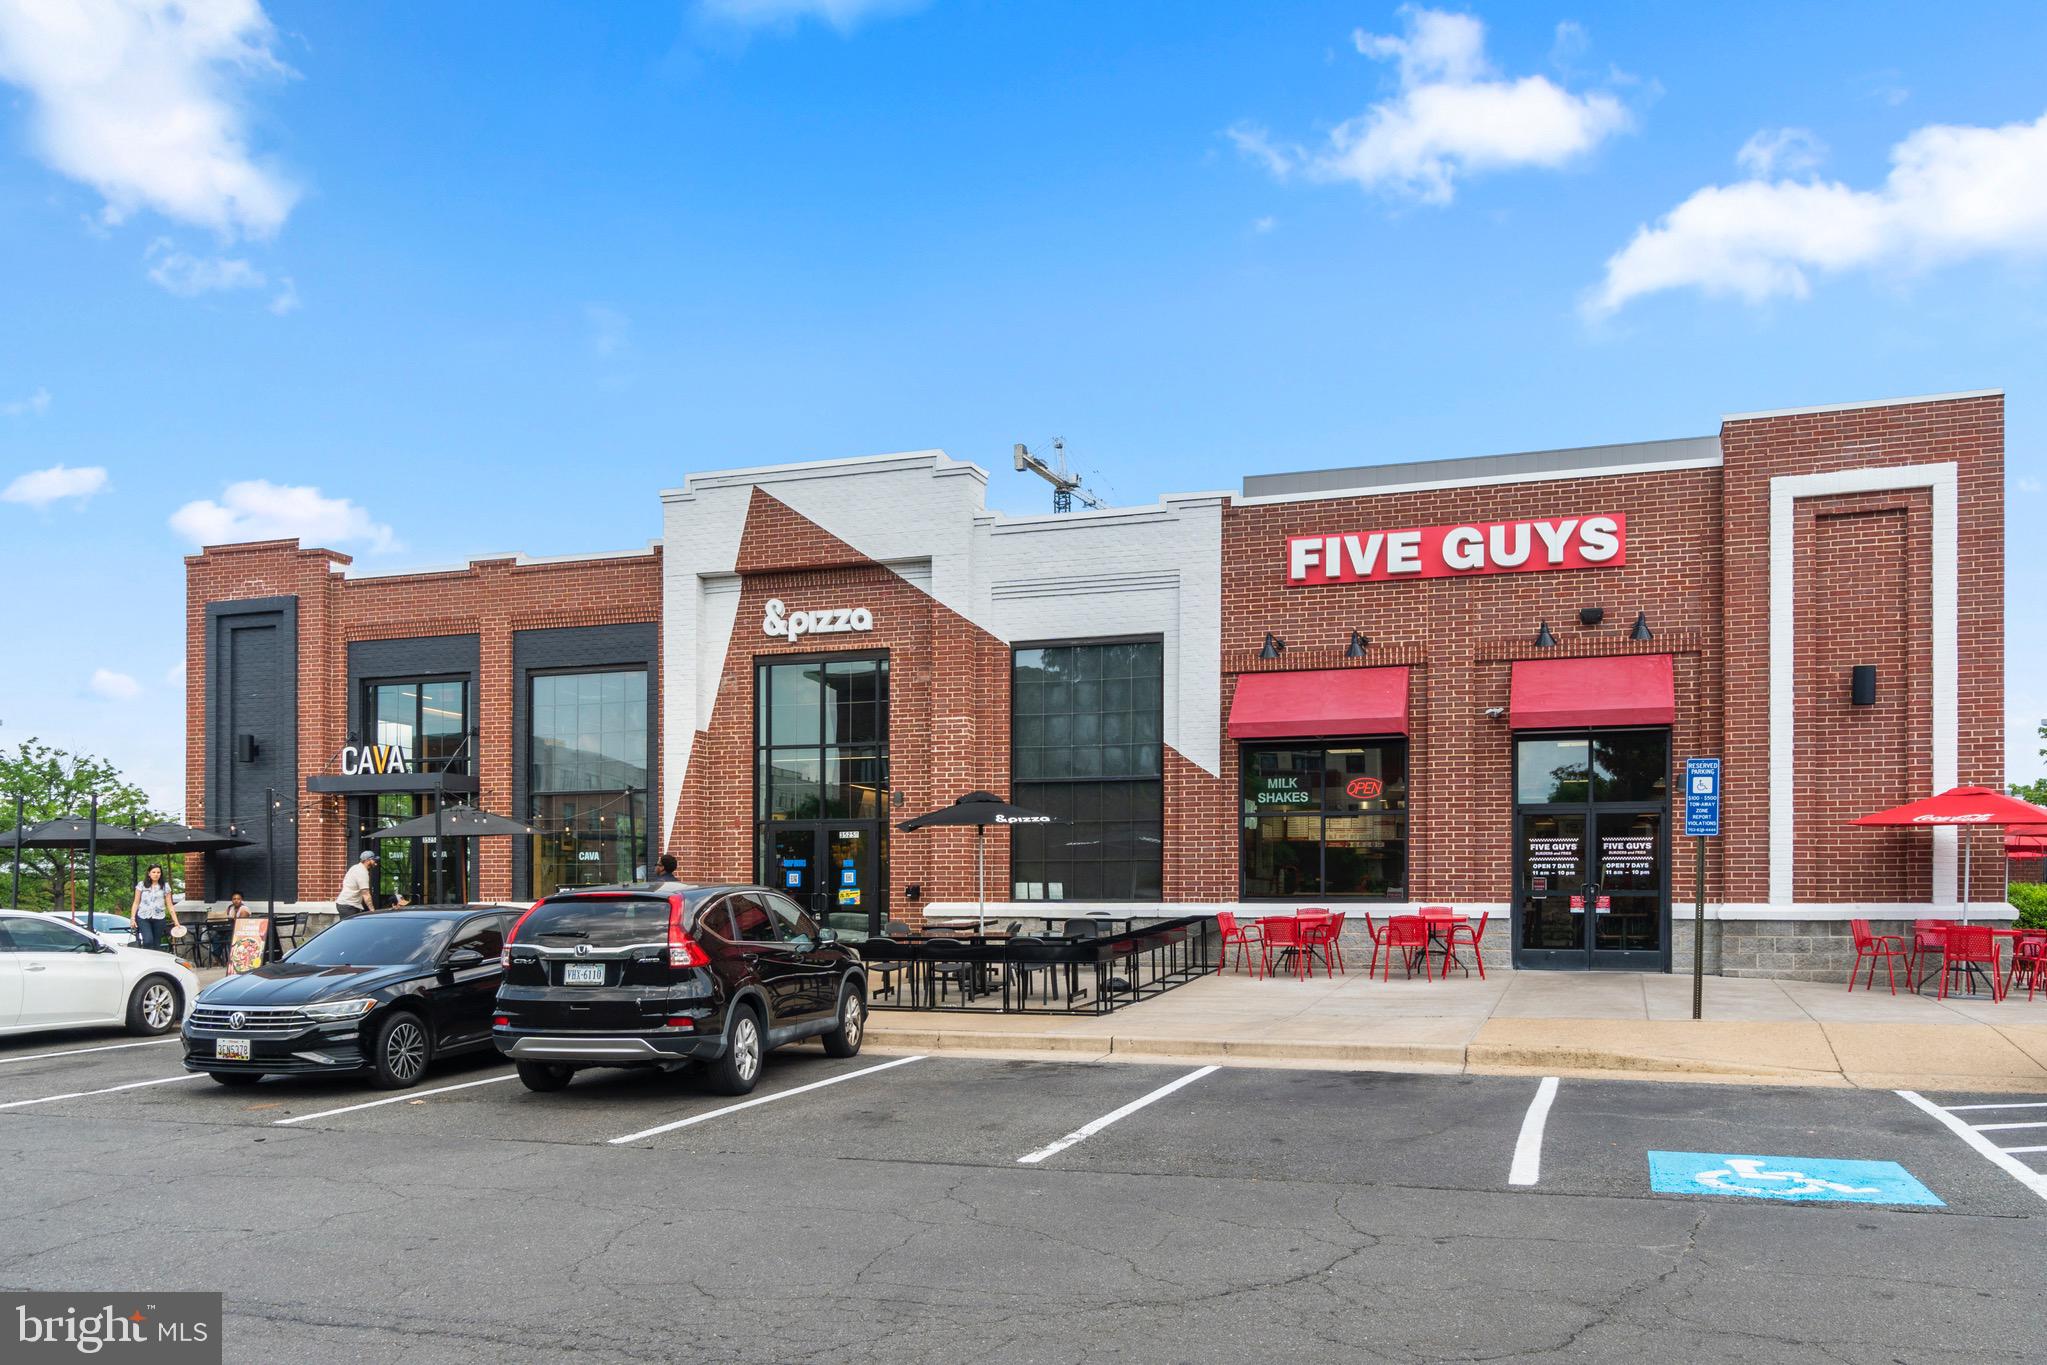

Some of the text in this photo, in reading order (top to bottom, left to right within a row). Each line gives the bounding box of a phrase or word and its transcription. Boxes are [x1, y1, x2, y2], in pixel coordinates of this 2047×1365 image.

[1291, 517, 1619, 579] FIVE GUYS
[763, 598, 873, 642] &pizza
[342, 745, 405, 775] CAVA
[1267, 777, 1298, 789] MILK
[1347, 780, 1382, 795] OPEN
[1257, 791, 1309, 803] SHAKES
[995, 814, 1051, 824] &pizza
[1530, 843, 1578, 851] FIVE GUYS
[1603, 842, 1652, 850] FIVE GUYS
[578, 851, 600, 861] CAVA
[567, 969, 602, 980] VHX-6110
